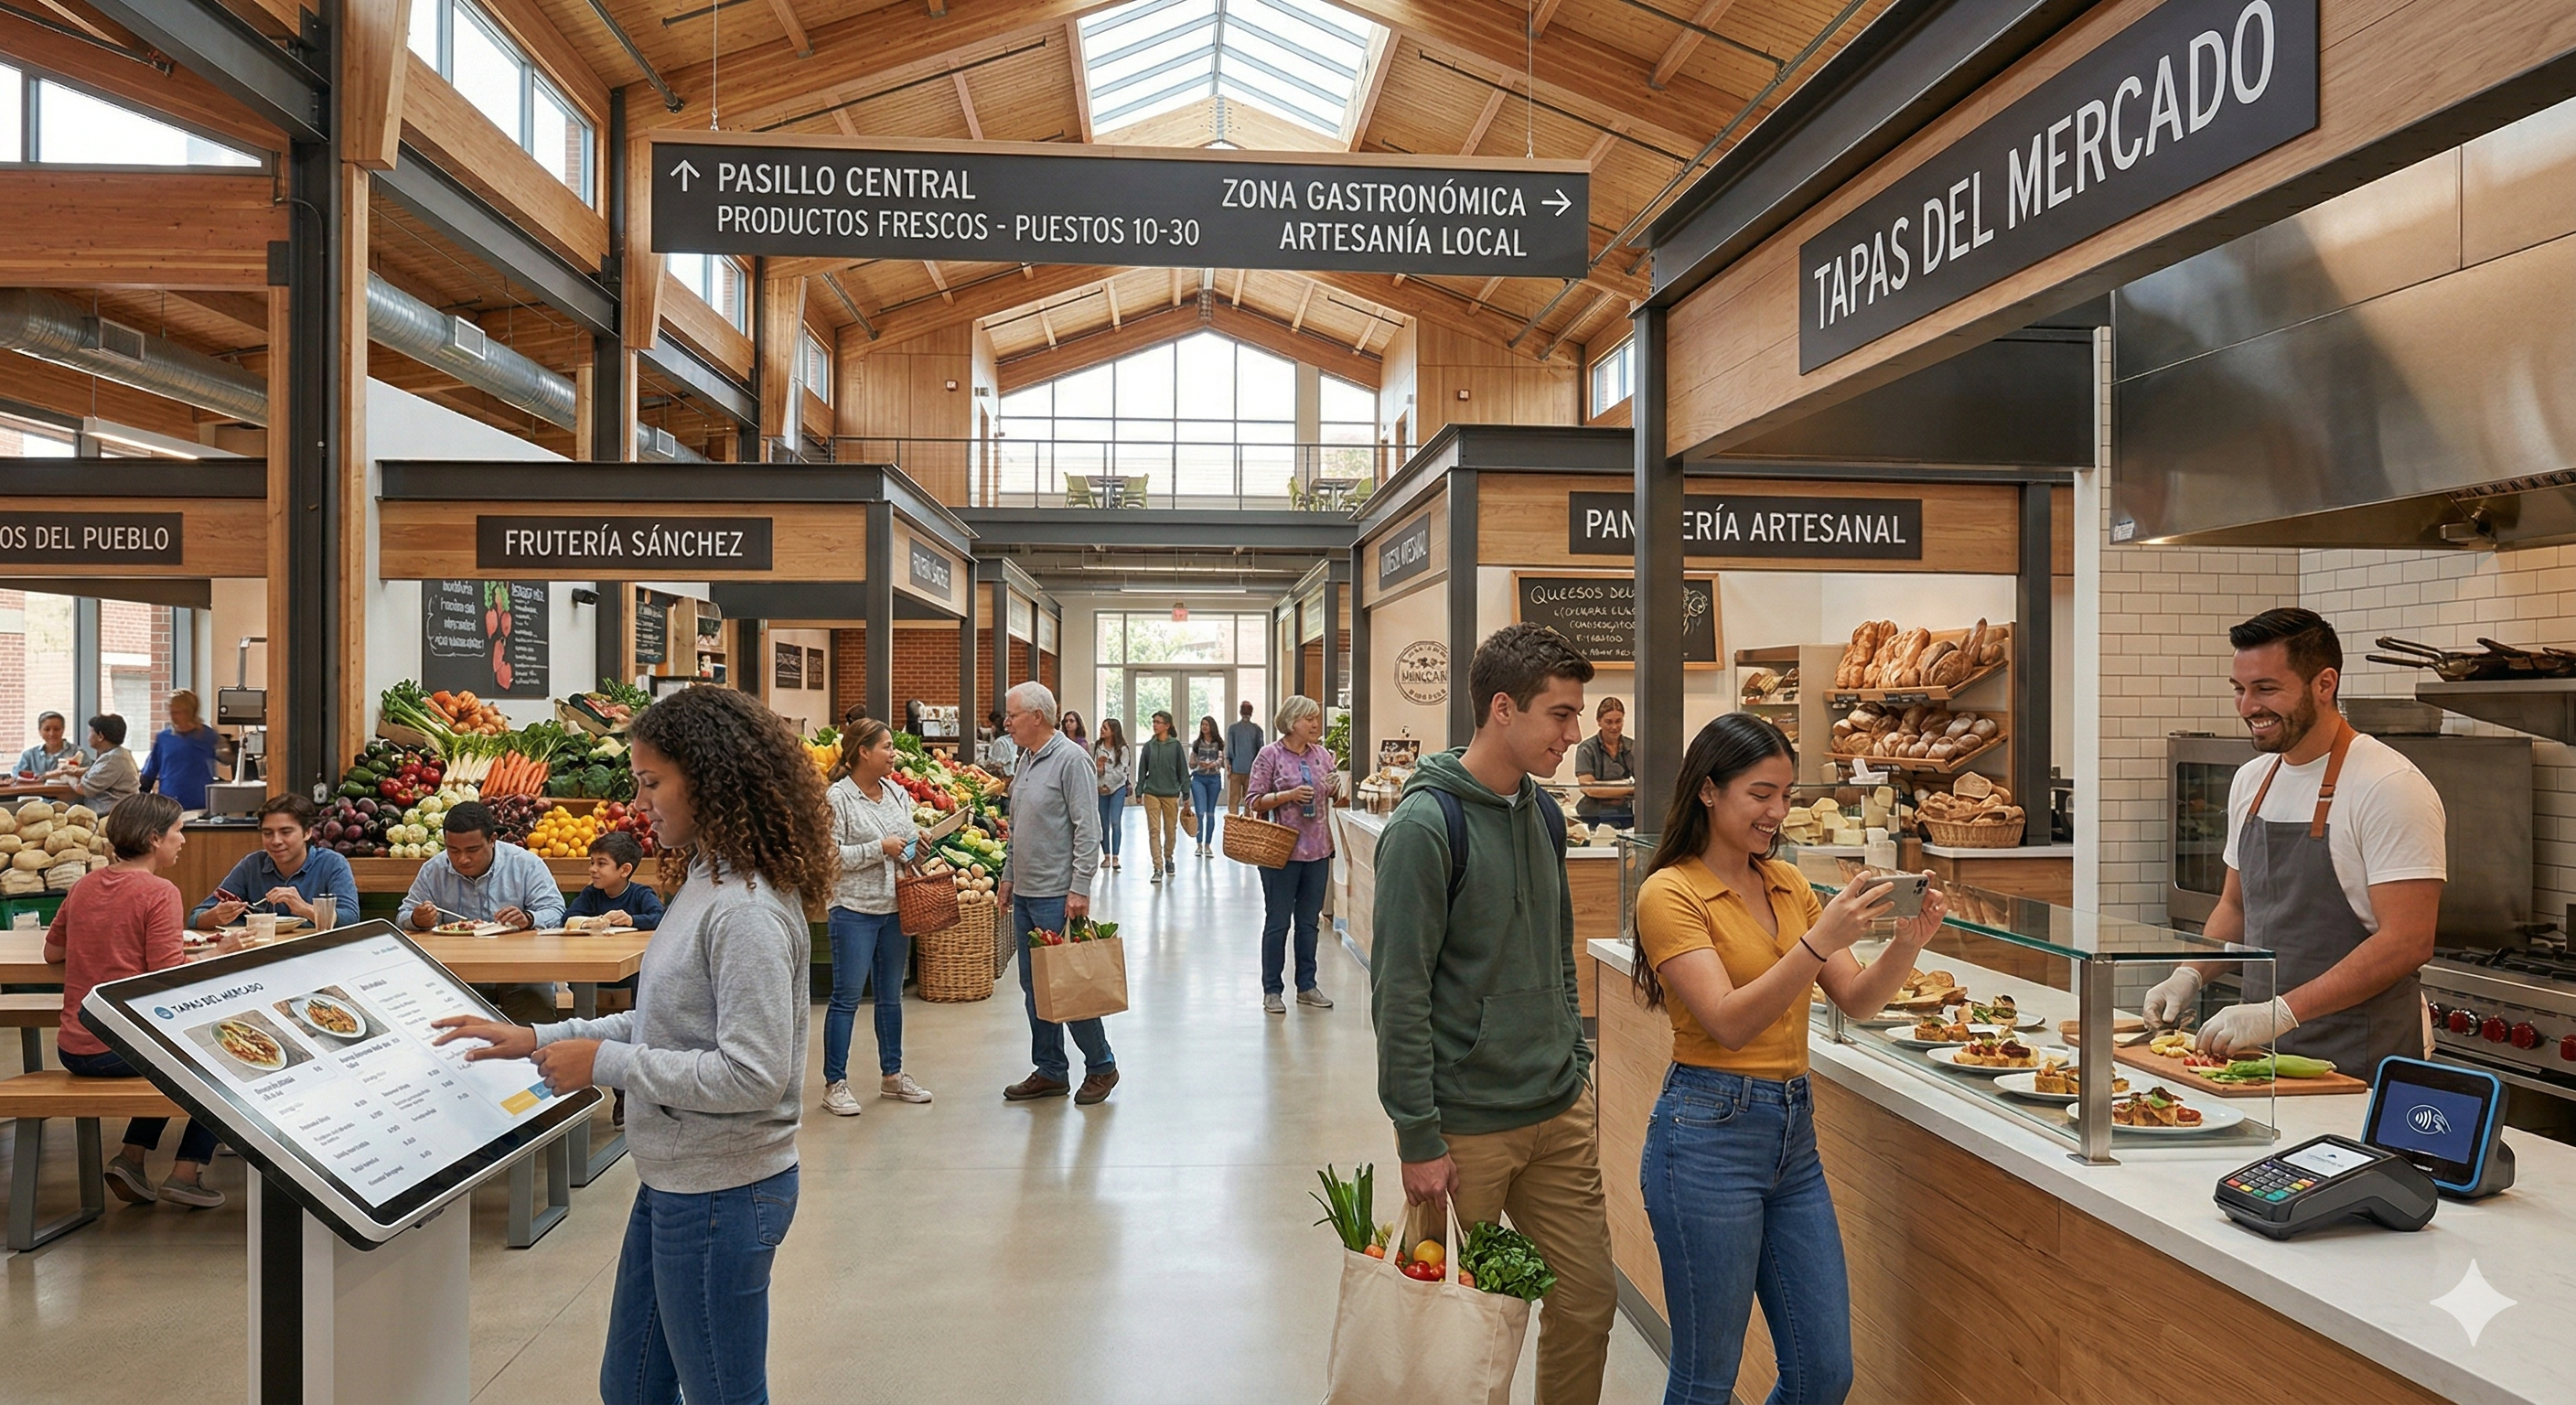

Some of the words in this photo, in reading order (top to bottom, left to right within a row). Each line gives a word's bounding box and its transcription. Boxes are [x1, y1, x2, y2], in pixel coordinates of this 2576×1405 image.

[719, 163, 835, 196] PASILLO
[846, 166, 976, 198] CENTRAL
[1814, 216, 1910, 330] TAPAS
[1923, 170, 1994, 275] DEL
[2008, 0, 2275, 230] MERCADO
[1221, 178, 1297, 209] ZONA
[1306, 177, 1527, 217] GASTRONÓMICA
[718, 205, 869, 237] PRODUCTOS
[878, 210, 988, 241] FRESCOS
[1015, 214, 1125, 244] PUESTOS
[1132, 218, 1200, 246] 10-30
[1279, 218, 1433, 254] ARTESANÍA
[1442, 226, 1528, 257] LOCAL
[36, 526, 75, 550] DEL
[83, 527, 169, 551] PUEBLO
[506, 523, 624, 556] FRUTERÍA
[631, 523, 744, 557] SÁNCHEZ
[1586, 503, 1741, 542] PANERÍA
[1749, 512, 1906, 543] ARTESANAL
[170, 1000, 203, 1014] TAPAS
